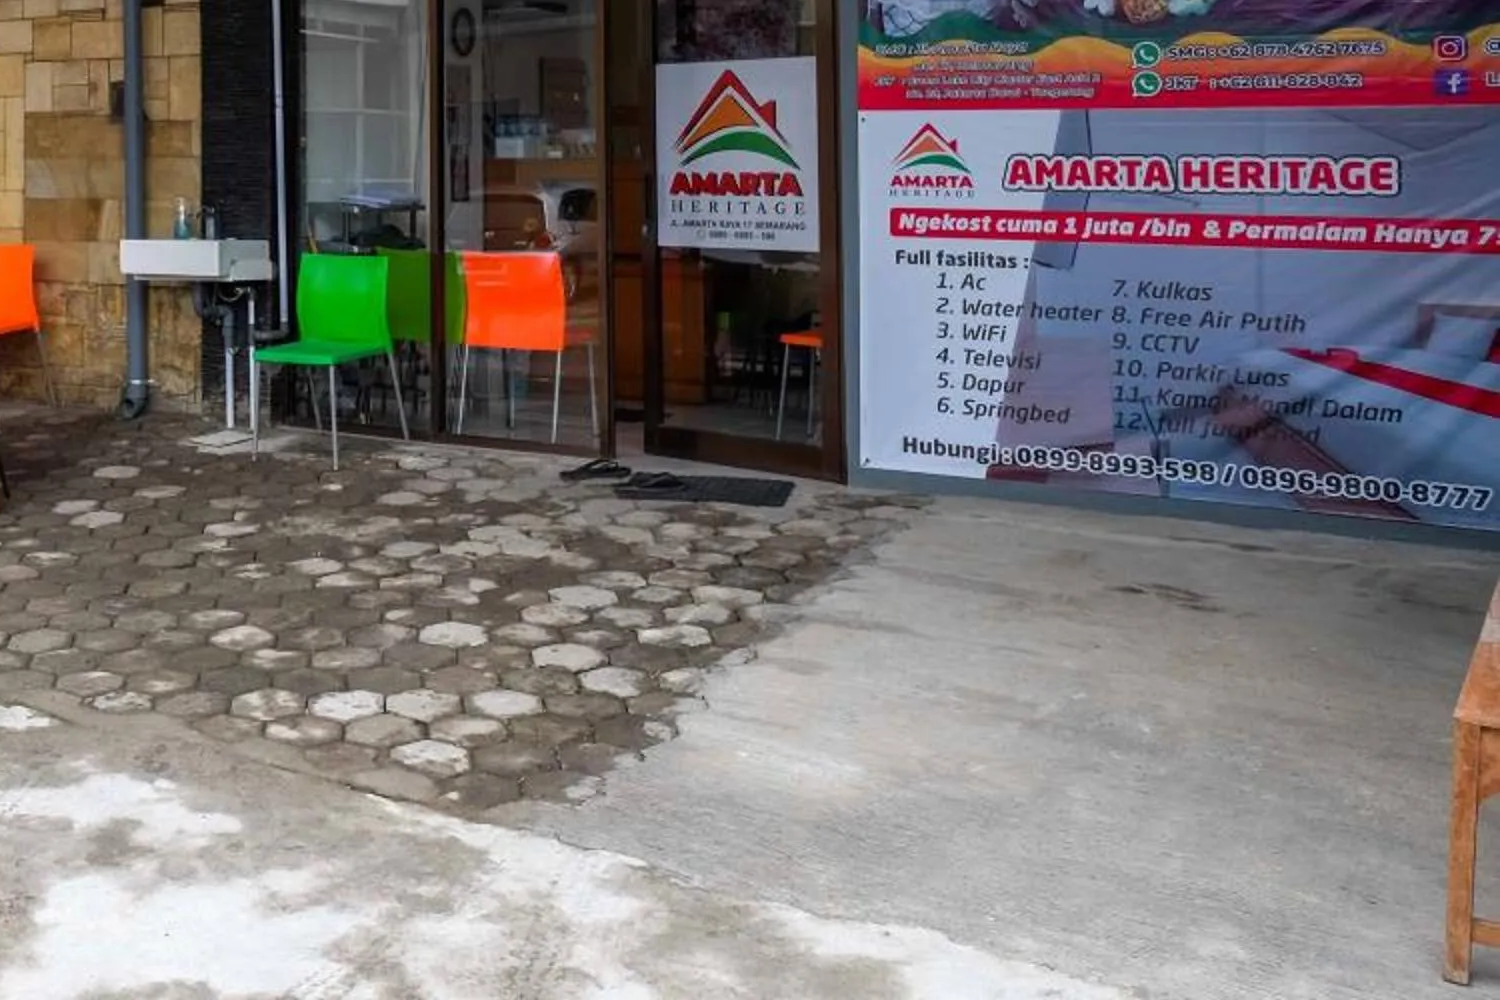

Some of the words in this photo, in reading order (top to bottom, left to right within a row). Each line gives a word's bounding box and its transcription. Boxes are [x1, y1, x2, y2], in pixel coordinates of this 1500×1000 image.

[670, 171, 804, 197] AMARTA
[890, 176, 973, 189] AMARTA
[1004, 155, 1174, 191] AMARTA
[1178, 155, 1399, 194] HERITAGE
[671, 199, 806, 216] HERITAGE
[899, 213, 992, 235] Ngekost
[996, 218, 1057, 234] cuma
[1063, 218, 1077, 234] 1
[1082, 217, 1134, 238] juta
[1203, 220, 1221, 238] &
[1228, 220, 1367, 243] Permalam
[1374, 223, 1468, 248] Hanya
[895, 250, 931, 266] Full
[937, 250, 1017, 269] fasilitas
[936, 273, 953, 290] 1.
[961, 274, 986, 291] Ac
[1112, 280, 1128, 298] 7.
[1137, 280, 1213, 301] Kulkas
[936, 298, 953, 315] 2.
[962, 299, 1025, 318] Water
[1030, 301, 1104, 322] heater
[1112, 306, 1131, 325] 8.
[1140, 307, 1191, 328] Free
[1200, 310, 1233, 330] Air
[1240, 312, 1306, 333] Putih
[936, 322, 953, 339] 3.
[963, 323, 1007, 342] WiFi
[1112, 333, 1131, 351] 9.
[1141, 334, 1200, 352] CCTV
[936, 347, 954, 364] 4.
[964, 348, 1041, 370] Televisi
[937, 372, 954, 389] 5.
[962, 373, 1026, 396] Dapur
[1112, 359, 1147, 378] 10.
[1156, 361, 1229, 383] Parkir
[1234, 368, 1291, 387] Luas
[937, 397, 954, 415] 6.
[962, 399, 1071, 425] Springbed
[1322, 398, 1404, 423] Dalam
[902, 436, 998, 465] Hubungi
[1017, 447, 1216, 483] 0899-8993-598
[1241, 465, 1493, 509] 0896-9800-8777
